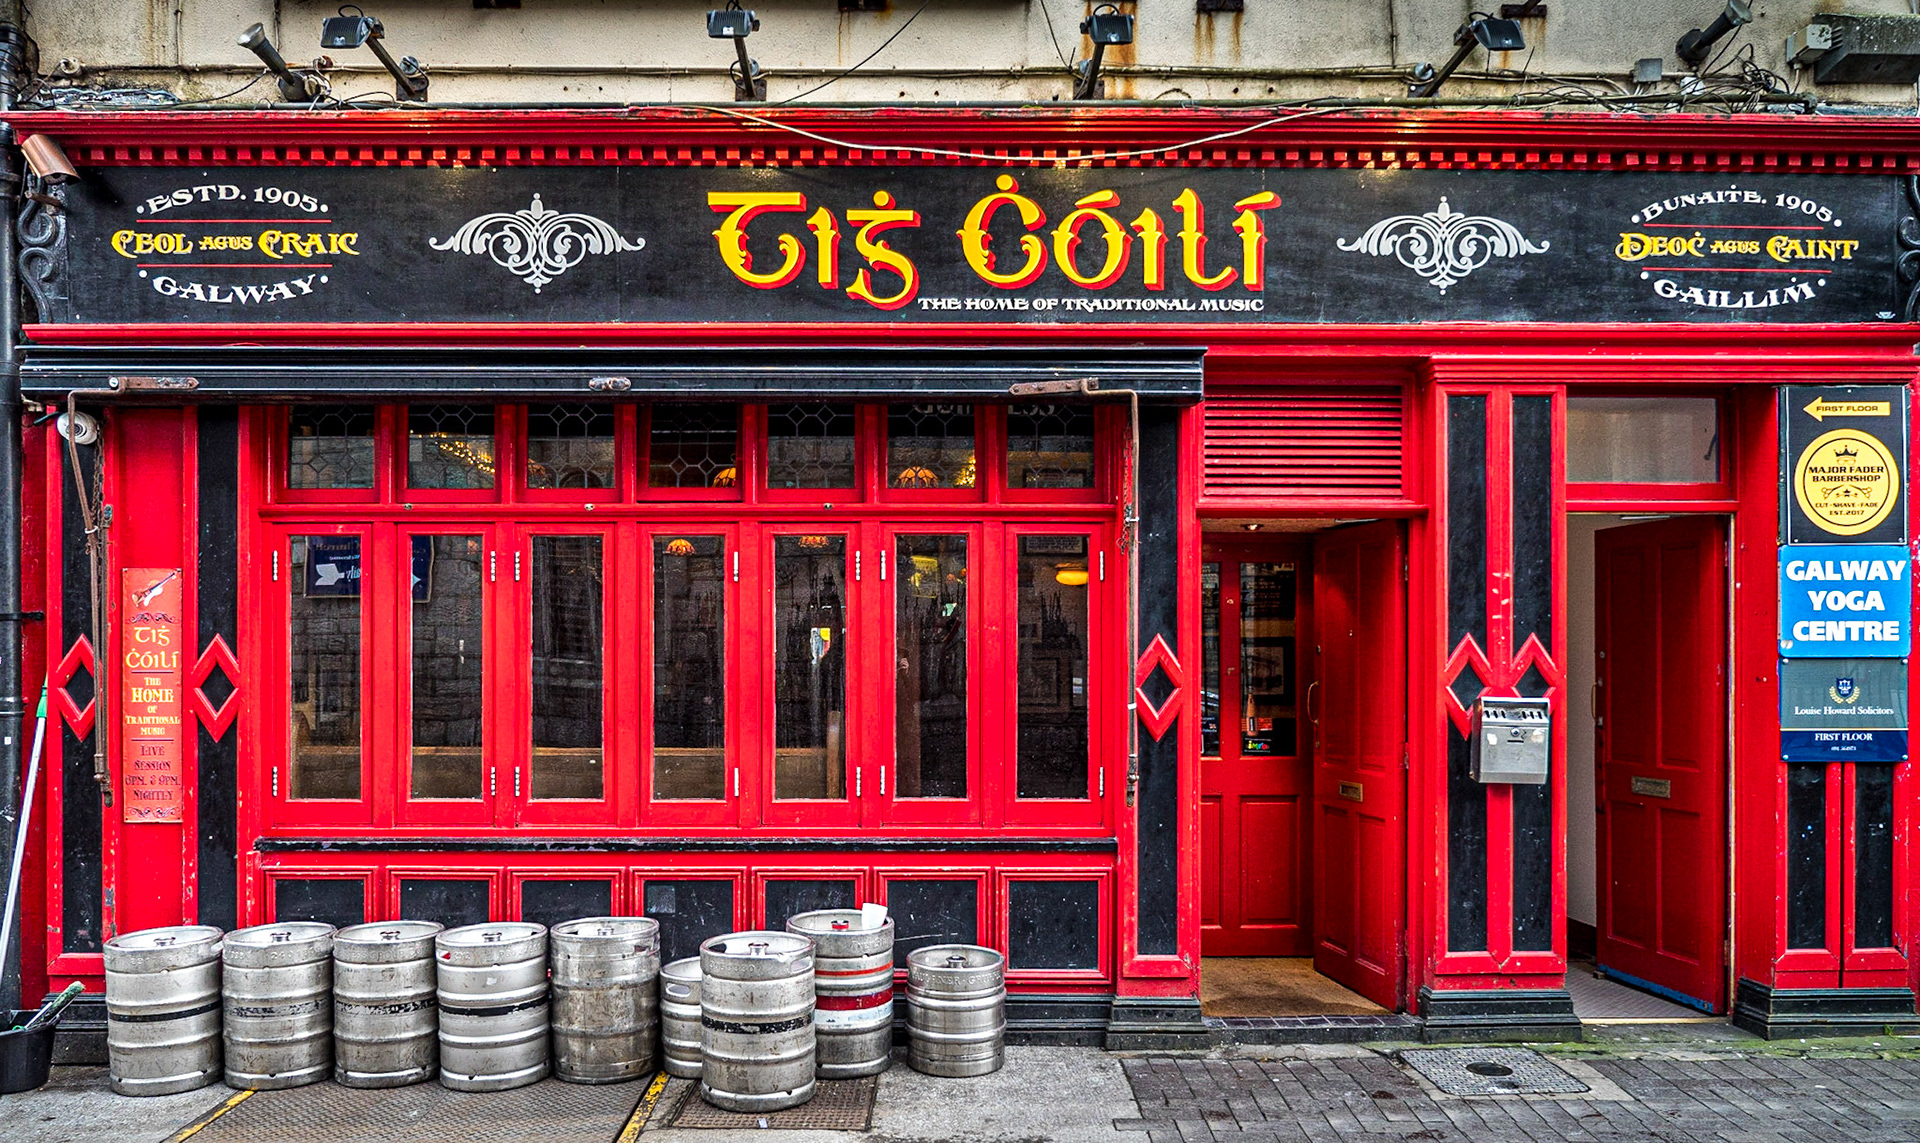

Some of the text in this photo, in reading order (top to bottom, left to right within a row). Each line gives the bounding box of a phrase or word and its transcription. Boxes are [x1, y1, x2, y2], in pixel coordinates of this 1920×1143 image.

[146, 184, 318, 214] ESTD. 1905
[1775, 193, 1834, 223] 1905
[111, 229, 193, 259] CEOL
[257, 229, 360, 259] CRAIC
[1766, 235, 1860, 263] CAINT
[152, 273, 317, 305] GALWAY
[917, 297, 1265, 313] THE HOME OF TRADITIONAL MUSIC
[1808, 466, 1847, 474] MAJOR
[1785, 560, 1907, 581] GALWAY
[1807, 590, 1886, 611] YOGA
[1792, 620, 1900, 641] CENTRE
[144, 677, 161, 686] THE
[131, 687, 174, 703] HOME
[147, 705, 158, 714] OF
[1794, 706, 1895, 715] Louise Howard Solicitors
[125, 715, 180, 725] TRADITIONAL
[140, 727, 166, 735] MUSIC
[1815, 733, 1873, 741] FIRST FLOOR
[141, 745, 165, 756] LIVE
[134, 760, 171, 770] SESSION
[133, 790, 174, 801] NIGHTLY
